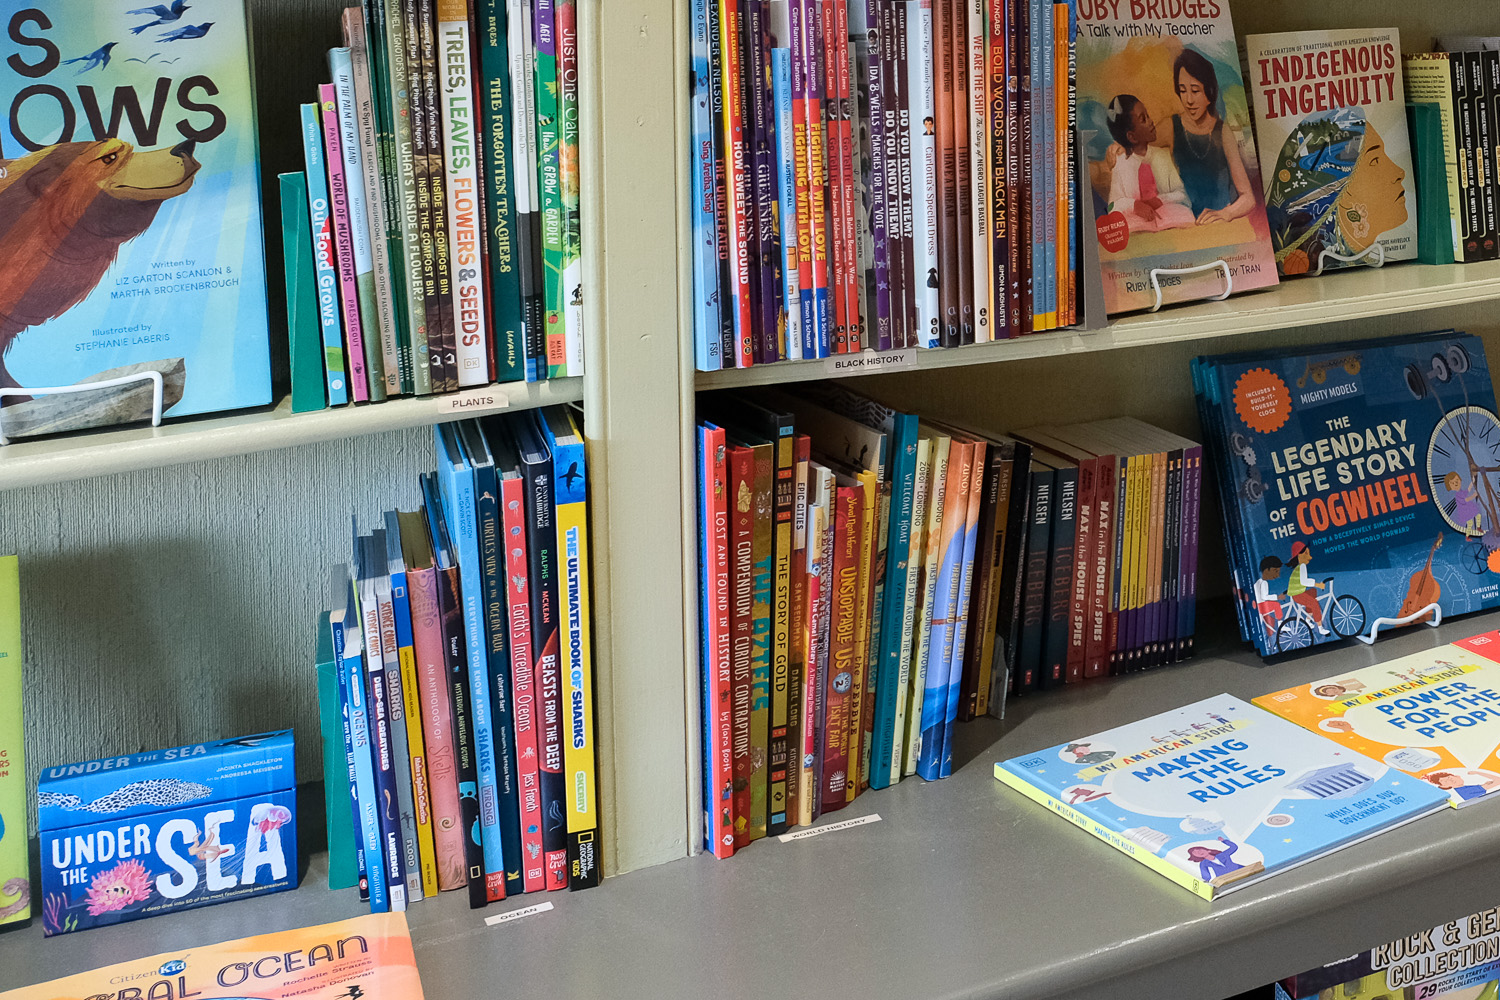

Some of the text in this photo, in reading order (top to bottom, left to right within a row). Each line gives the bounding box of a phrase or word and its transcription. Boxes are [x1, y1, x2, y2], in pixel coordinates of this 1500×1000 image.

[1086, 23, 1110, 37] Talk
[1114, 23, 1142, 37] with
[1144, 23, 1163, 38] My
[1166, 22, 1215, 36] Teacher
[1258, 43, 1395, 86] INDIGENOUS
[1263, 72, 1395, 119] INGENUITY
[445, 26, 480, 347] TREES, LEAVES, FLOWERS & SEEDS
[111, 279, 239, 299] MARTHA BROCKENBROUGH
[116, 266, 232, 286] LIZ GARTON SCANLON &
[835, 354, 904, 369] BLACK HISTORY
[452, 396, 494, 408] PLANTS
[1300, 382, 1358, 405] MIGHTY MODELS
[1326, 416, 1351, 431] THE
[1270, 419, 1408, 474] LEGENDARY
[1276, 444, 1417, 501] LIFE STORY
[1269, 473, 1428, 541] THE COGWHEEL
[1269, 507, 1288, 522] OF
[1375, 680, 1478, 717] POWER
[1387, 704, 1443, 730] FOR
[1131, 739, 1250, 783] MAKING
[1179, 760, 1249, 784] THE
[1187, 765, 1286, 803] RULES
[792, 818, 866, 839] WORLD HISTORY
[52, 823, 152, 868] UNDER
[155, 803, 288, 900] SEA
[60, 867, 88, 886] THE
[500, 906, 539, 922] OCEAN
[217, 935, 369, 986] OCEAN
